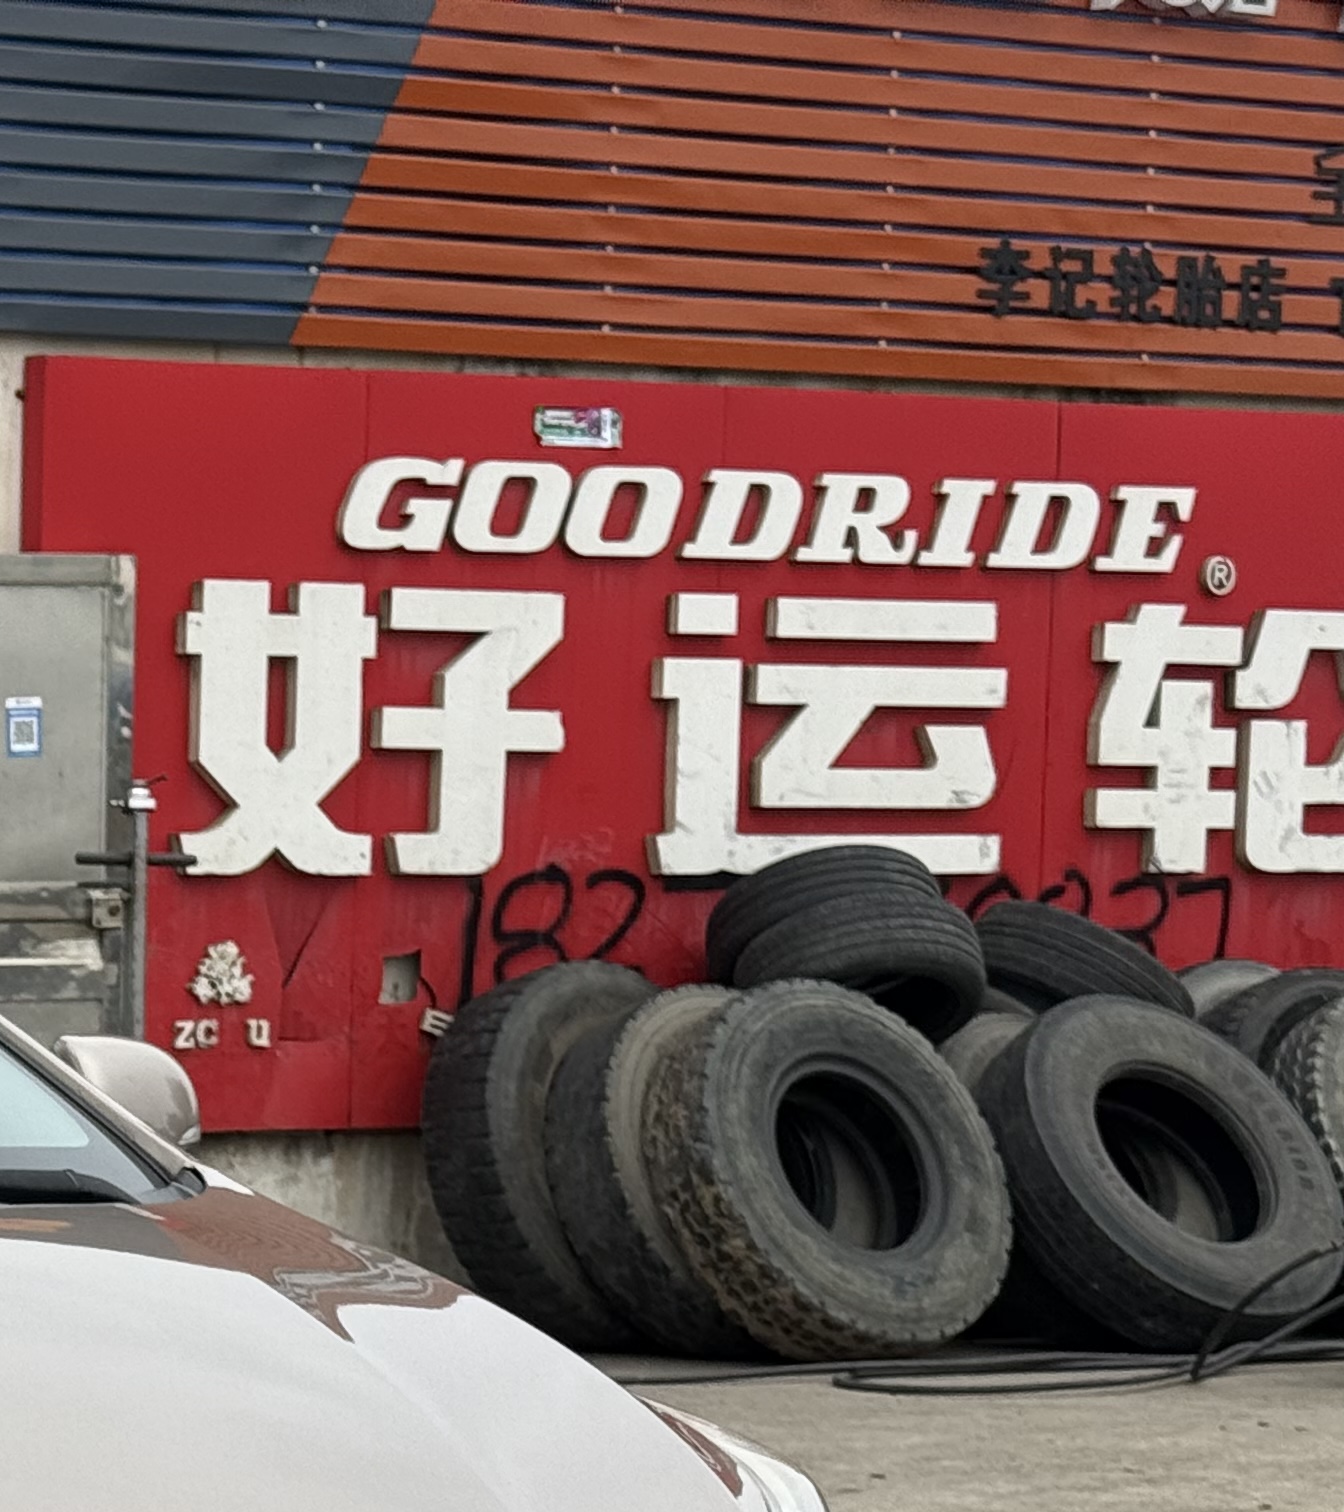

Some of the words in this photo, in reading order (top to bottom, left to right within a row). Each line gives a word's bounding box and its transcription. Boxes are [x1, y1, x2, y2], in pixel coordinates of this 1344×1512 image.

[974, 237, 1288, 332] 李记轮胎店
[337, 456, 1196, 575] GOODRIDE
[170, 578, 1344, 877] 好运轮
[173, 1018, 220, 1049] ZC
[245, 1017, 272, 1048] U
